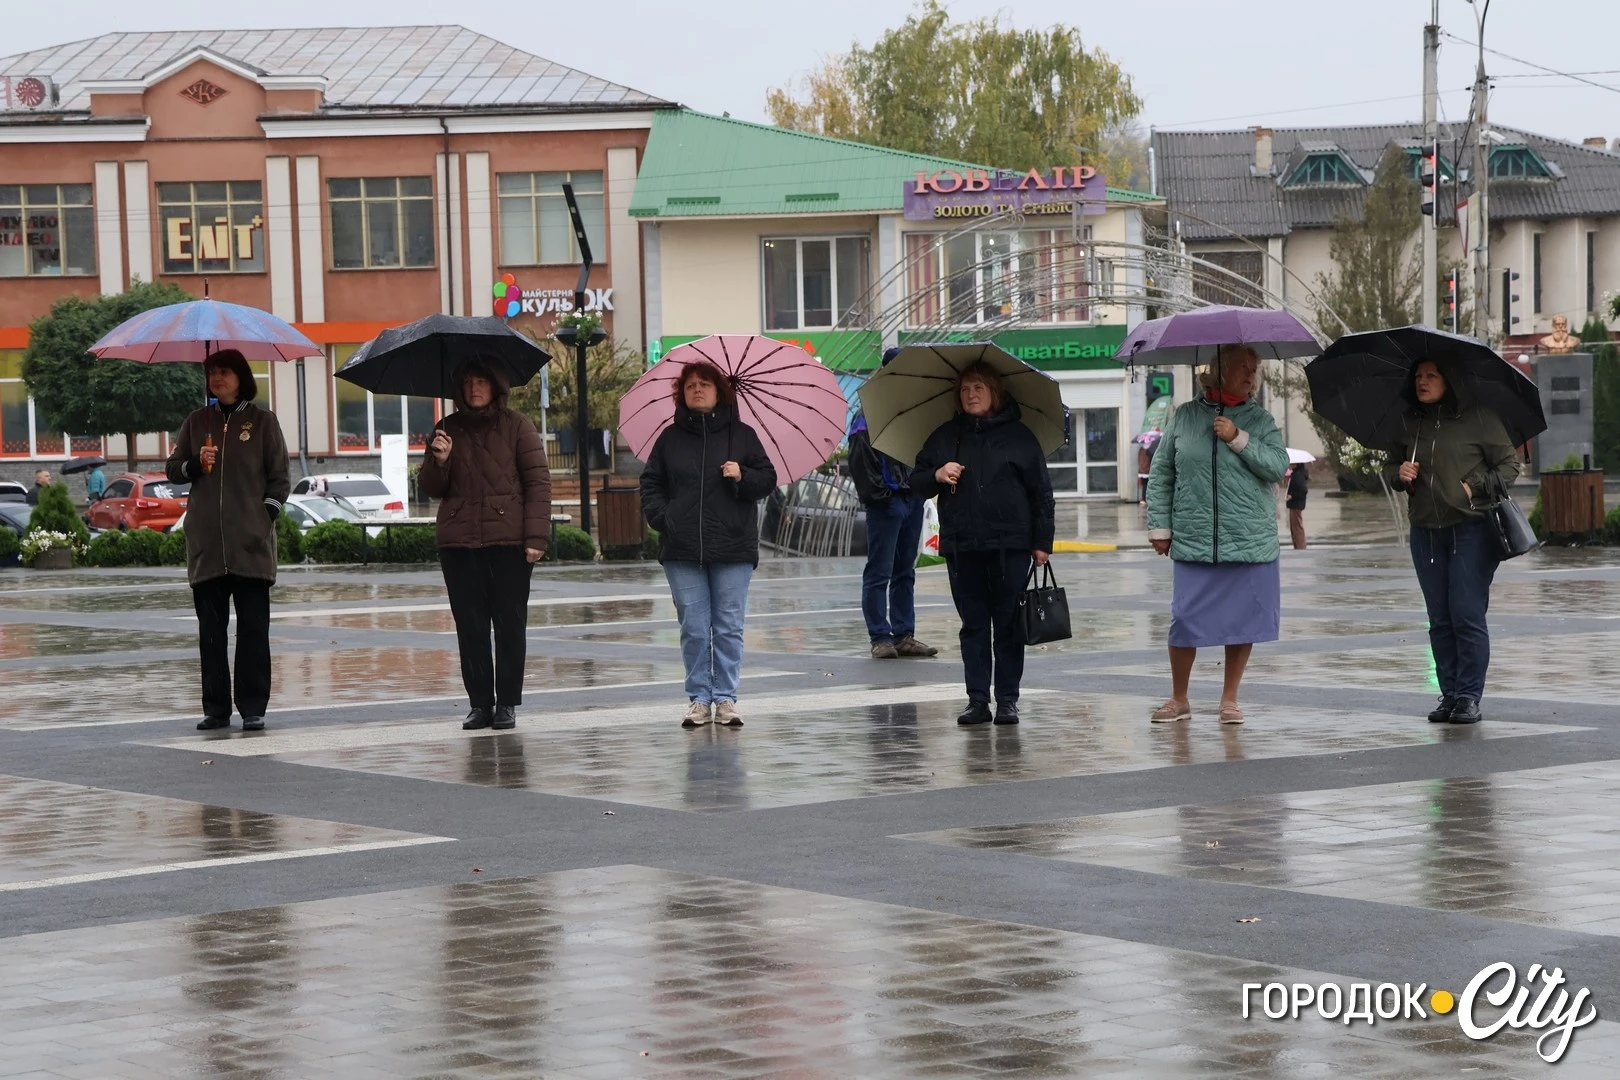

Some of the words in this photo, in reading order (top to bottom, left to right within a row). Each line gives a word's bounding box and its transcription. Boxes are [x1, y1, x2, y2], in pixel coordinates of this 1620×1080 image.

[913, 165, 1097, 194] ЮВЕЛІР
[933, 203, 992, 218] ЗОЛОТО
[996, 202, 1016, 215] ТА
[522, 288, 574, 298] МАЙСТЕРНЯ
